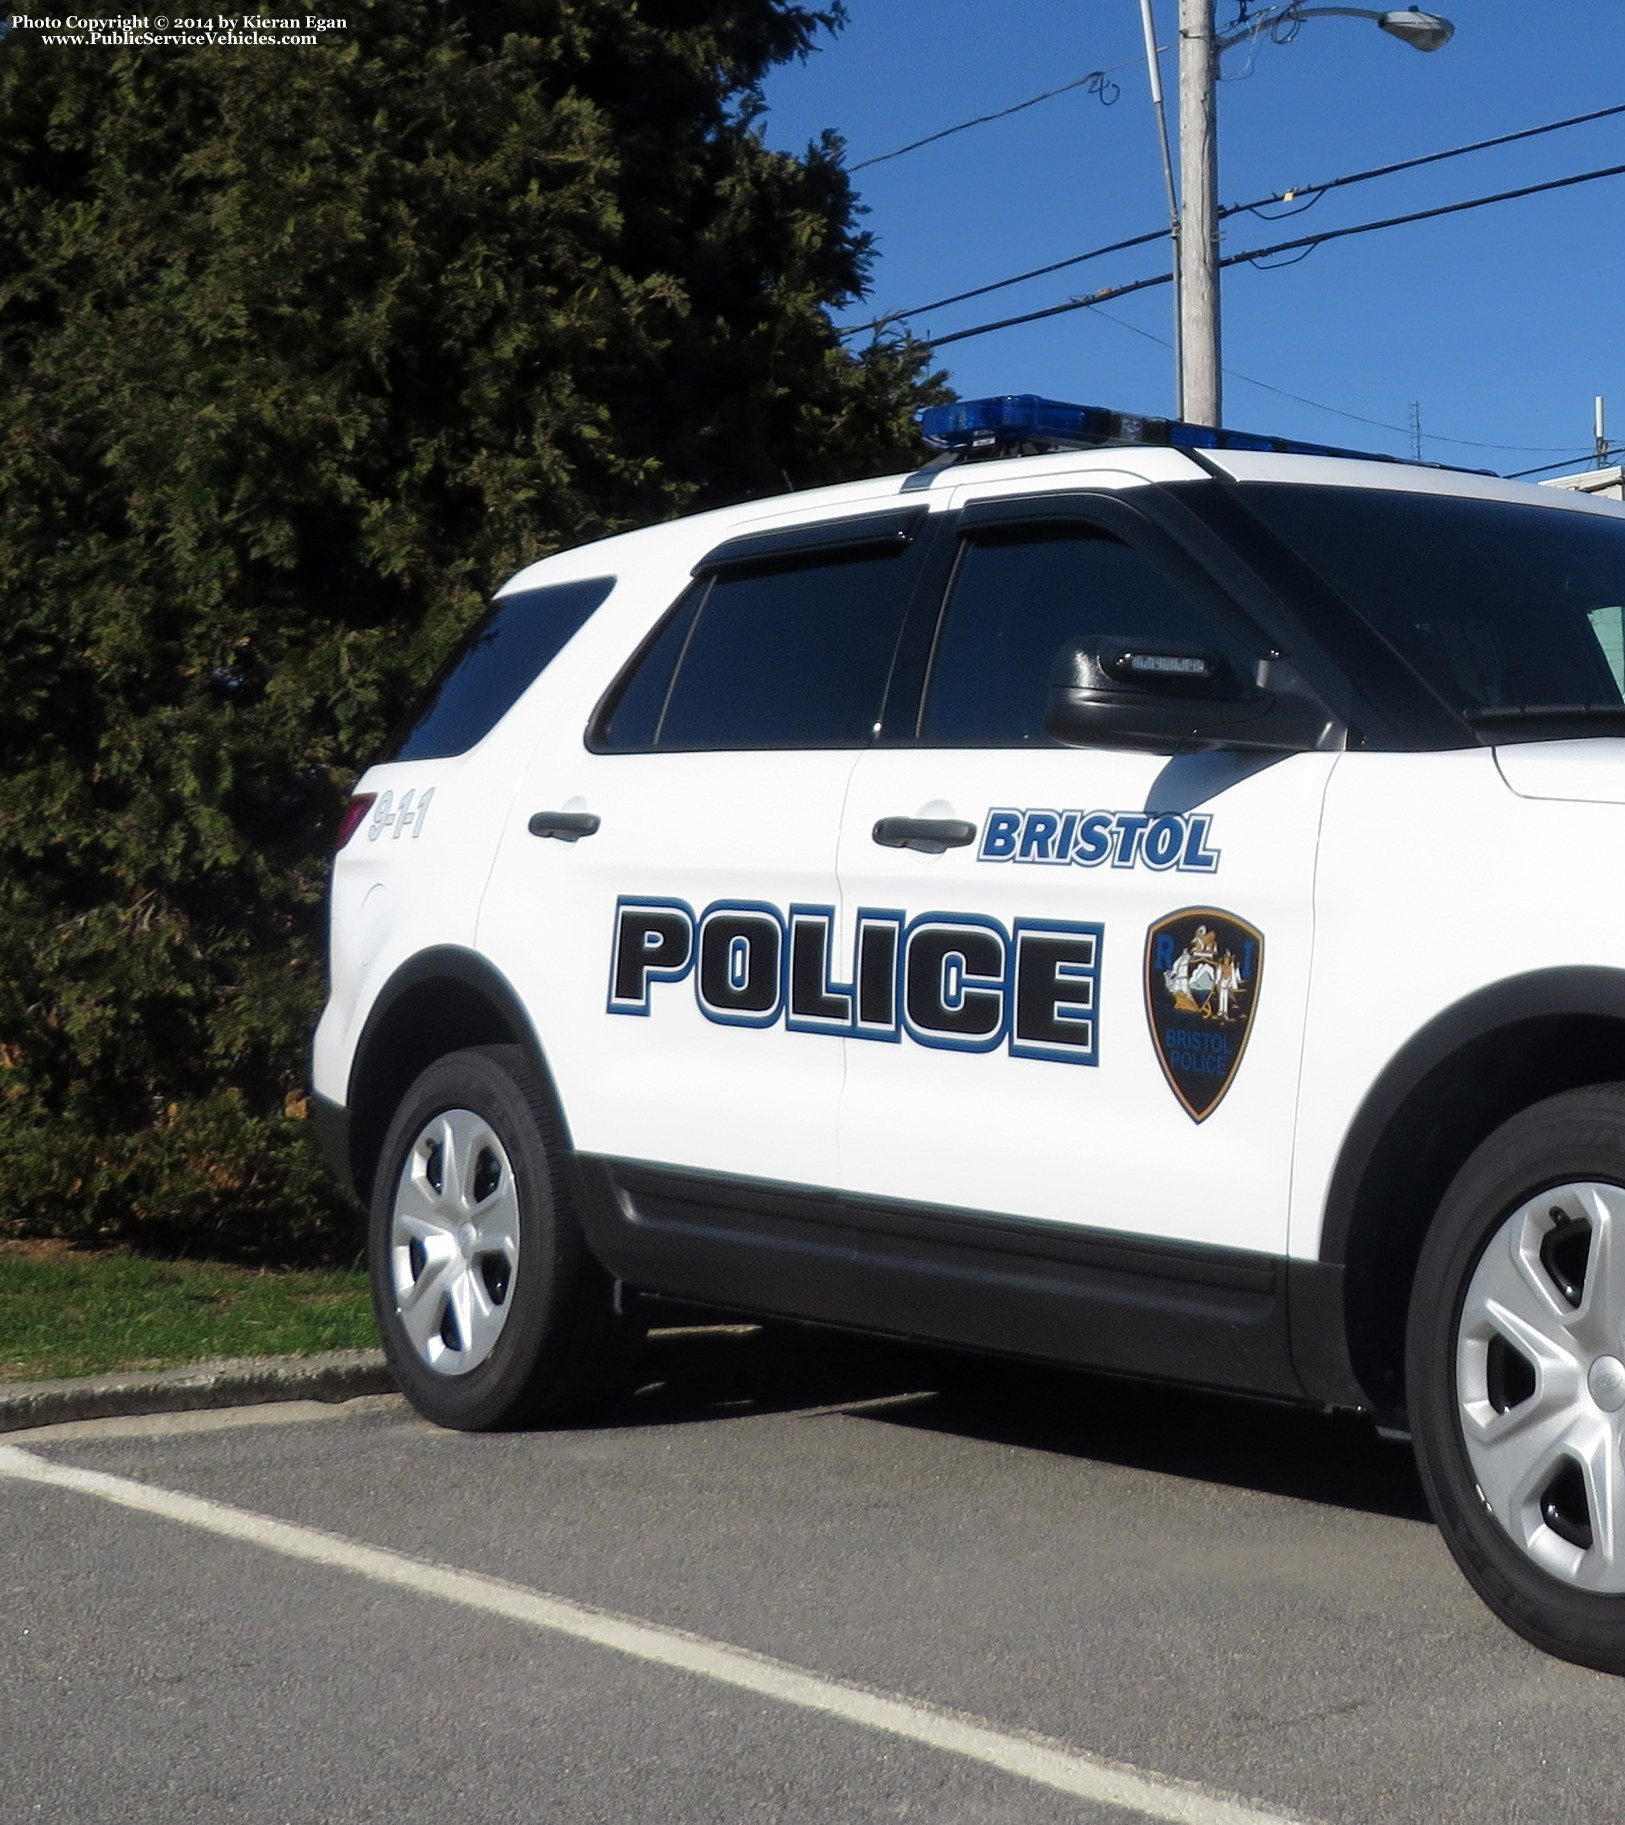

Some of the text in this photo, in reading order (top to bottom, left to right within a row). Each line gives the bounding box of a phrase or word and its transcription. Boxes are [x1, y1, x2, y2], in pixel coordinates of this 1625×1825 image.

[368, 786, 437, 842] 9-1-1
[976, 807, 1222, 875] BRISTOL
[606, 894, 1106, 1068] POLICE
[1154, 933, 1256, 979] R I
[1166, 1028, 1233, 1055] BRISTOL
[1170, 1050, 1227, 1076] POLICE
